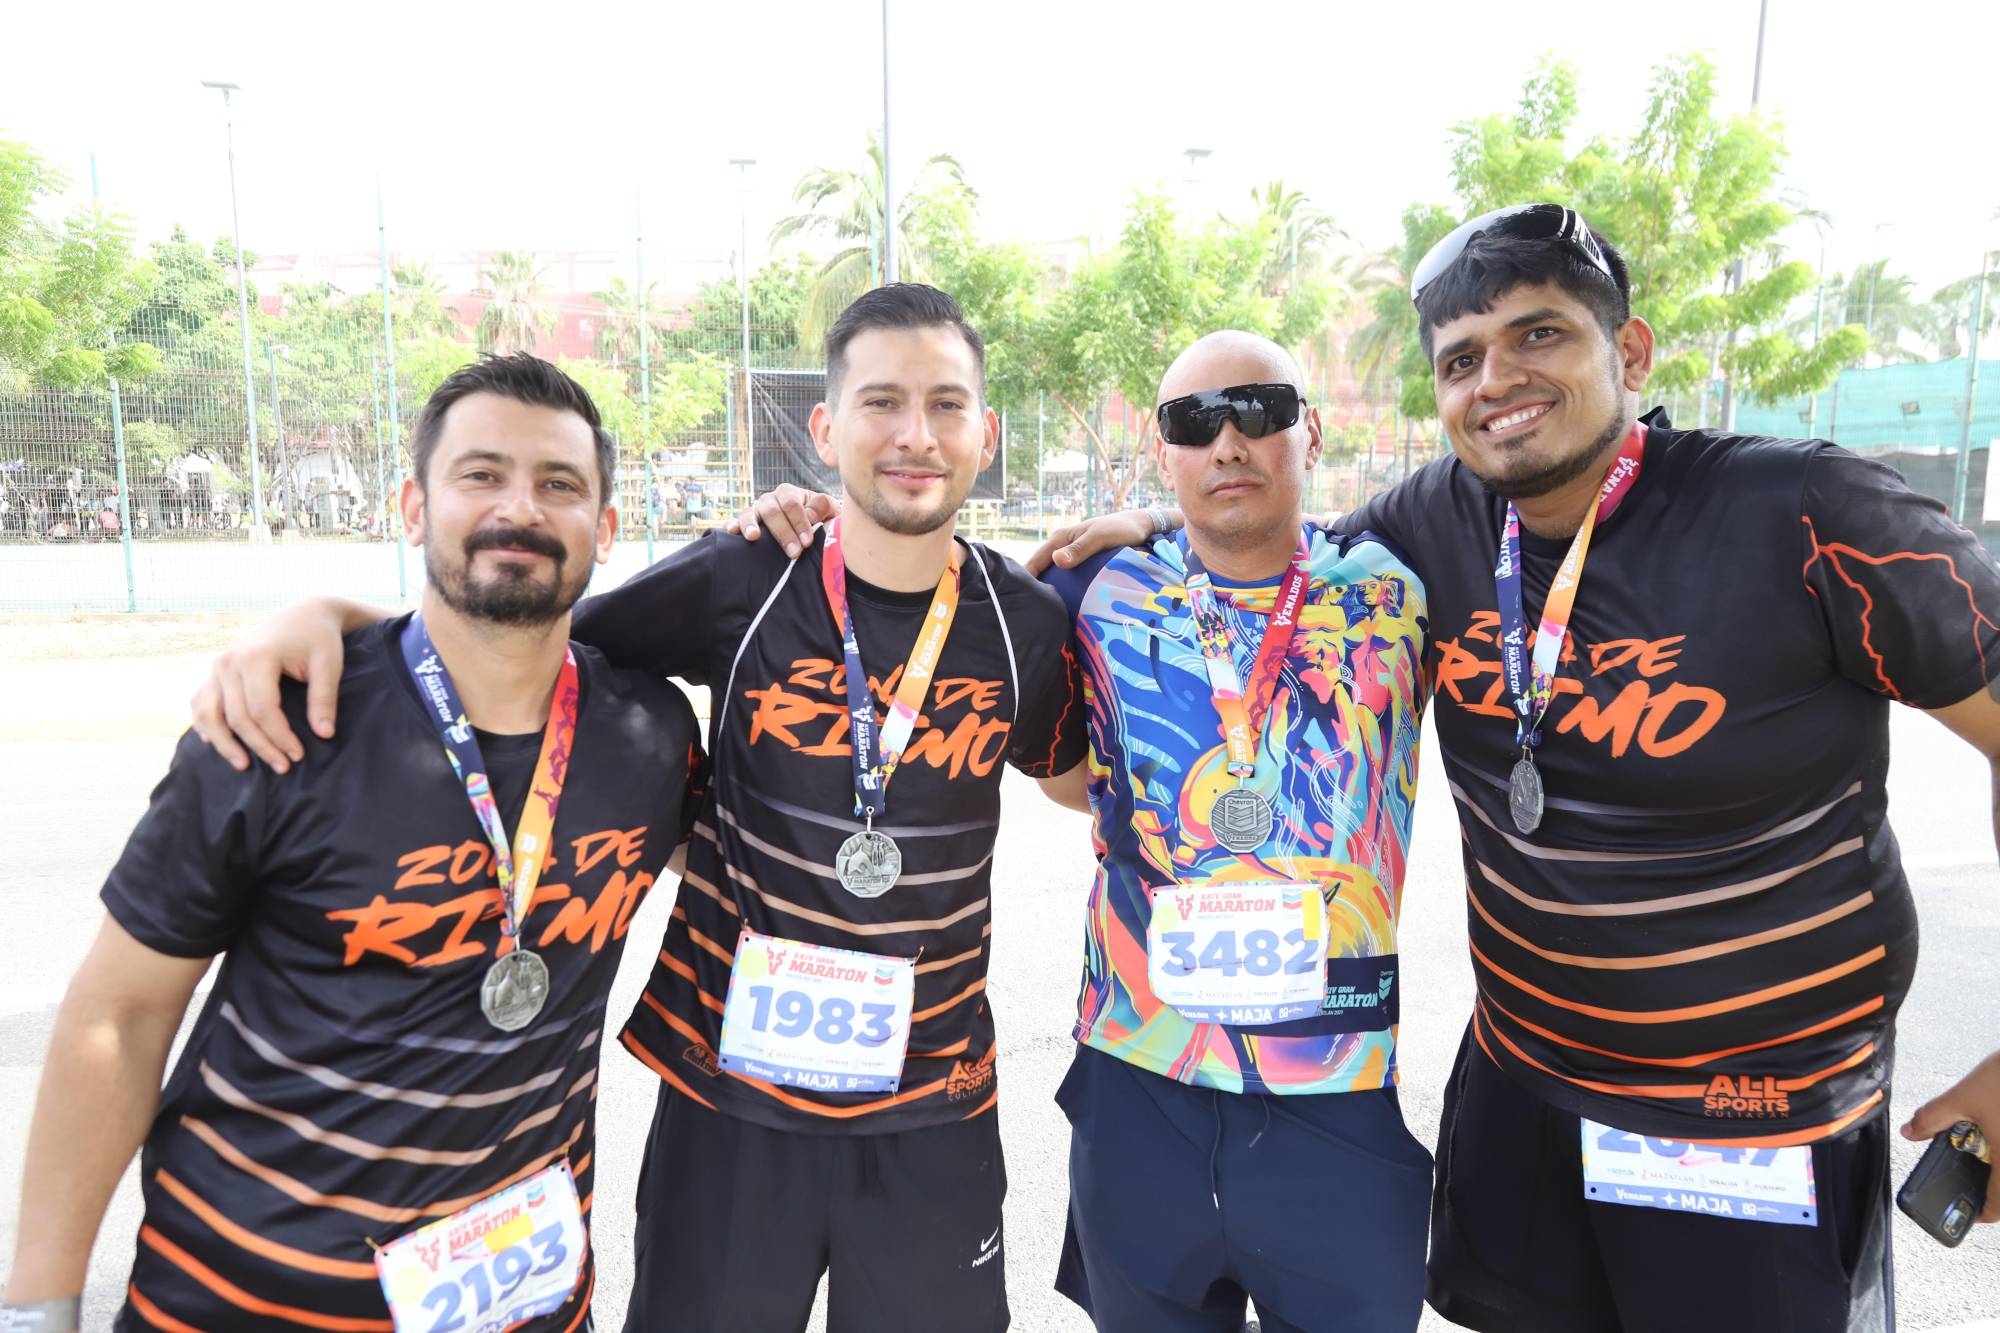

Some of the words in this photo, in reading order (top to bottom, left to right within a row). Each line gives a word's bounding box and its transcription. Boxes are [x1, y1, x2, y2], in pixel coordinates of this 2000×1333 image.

[1587, 634, 1687, 677] DE
[933, 677, 1004, 711] DE
[571, 826, 648, 877] DE
[1160, 929, 1319, 977] 3482
[749, 985, 897, 1048] 1983
[1231, 1008, 1273, 1023] MAJA
[796, 1071, 838, 1089] MAJA
[1705, 1074, 1788, 1099] ALL
[1704, 1096, 1790, 1113] SPORTS
[1680, 1193, 1733, 1216] MAJA
[972, 1240, 999, 1268] NIKE
[421, 1221, 567, 1333] 2193
